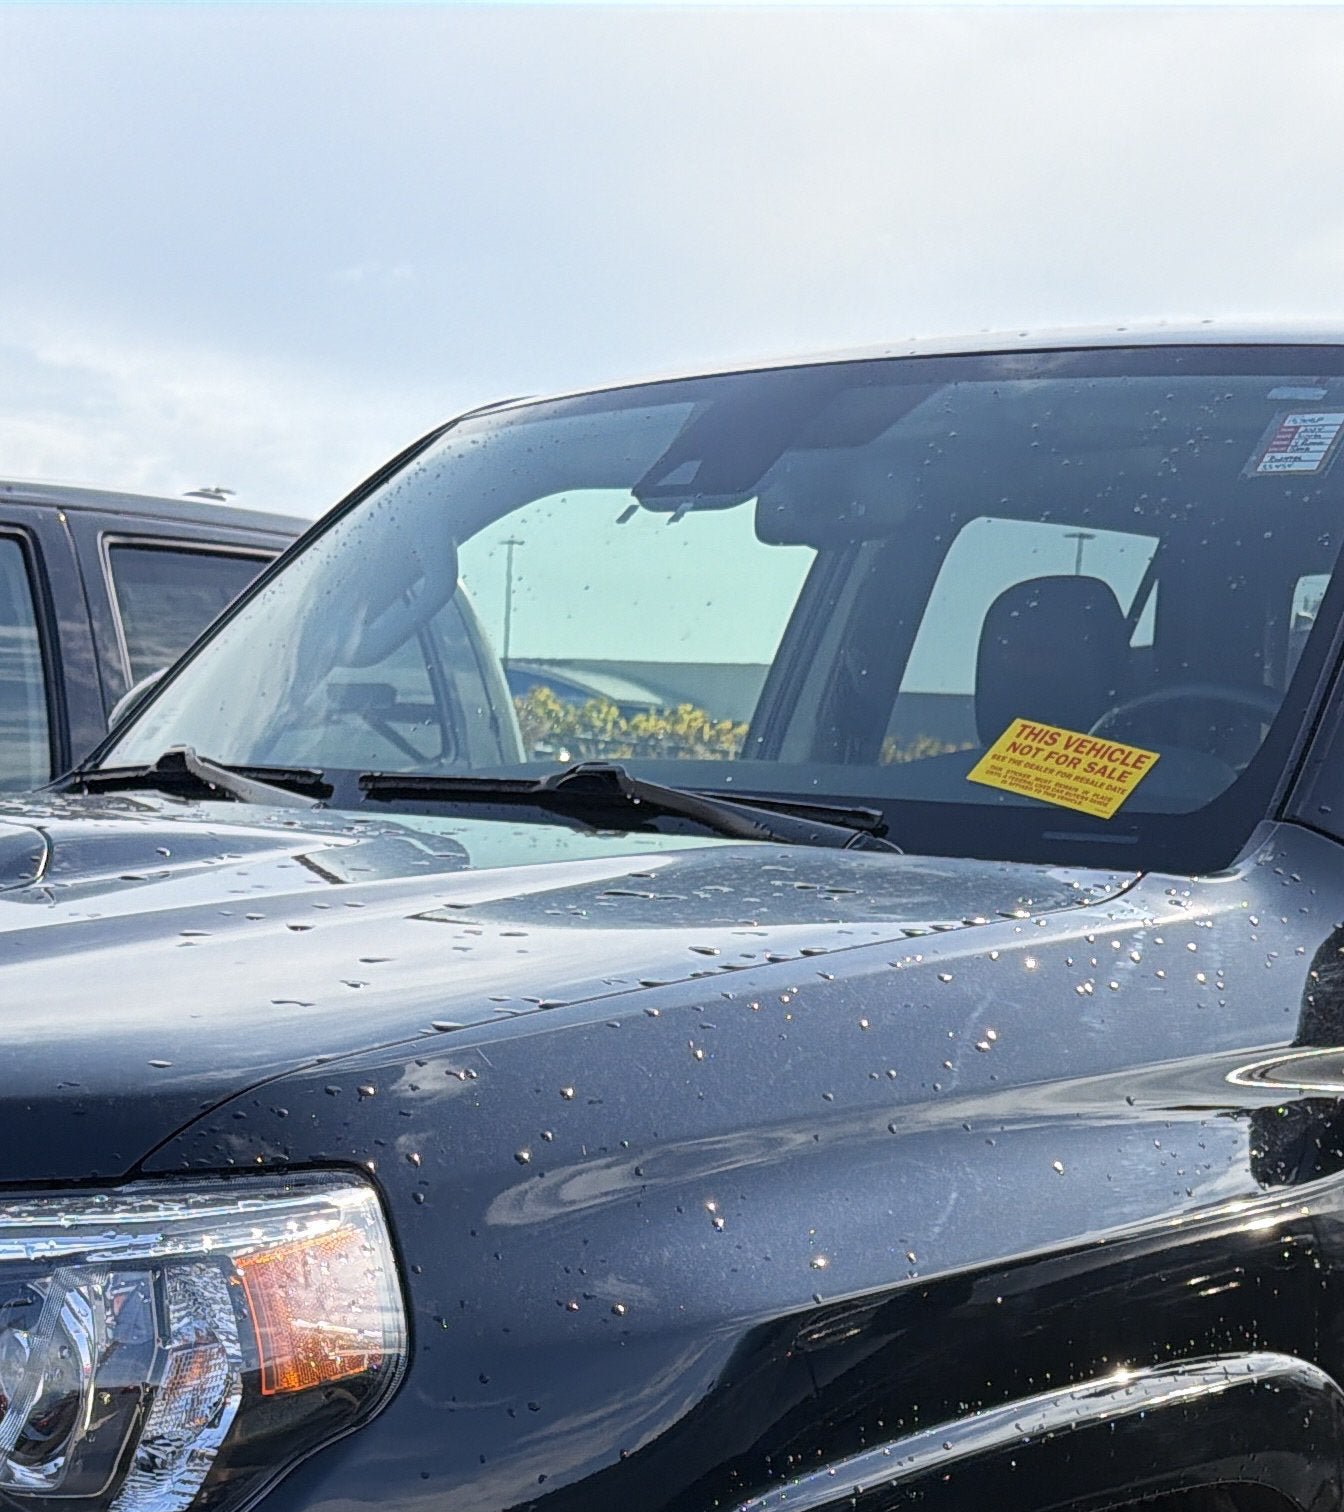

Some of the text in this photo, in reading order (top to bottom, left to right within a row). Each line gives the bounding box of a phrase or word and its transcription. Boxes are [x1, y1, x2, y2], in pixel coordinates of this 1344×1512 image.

[1006, 741, 1133, 783] NOT FOR SALE
[1014, 723, 1151, 771] THIS VEHICLE
[991, 753, 1128, 795] SEE THE DEALER FOR RESALE DATE
